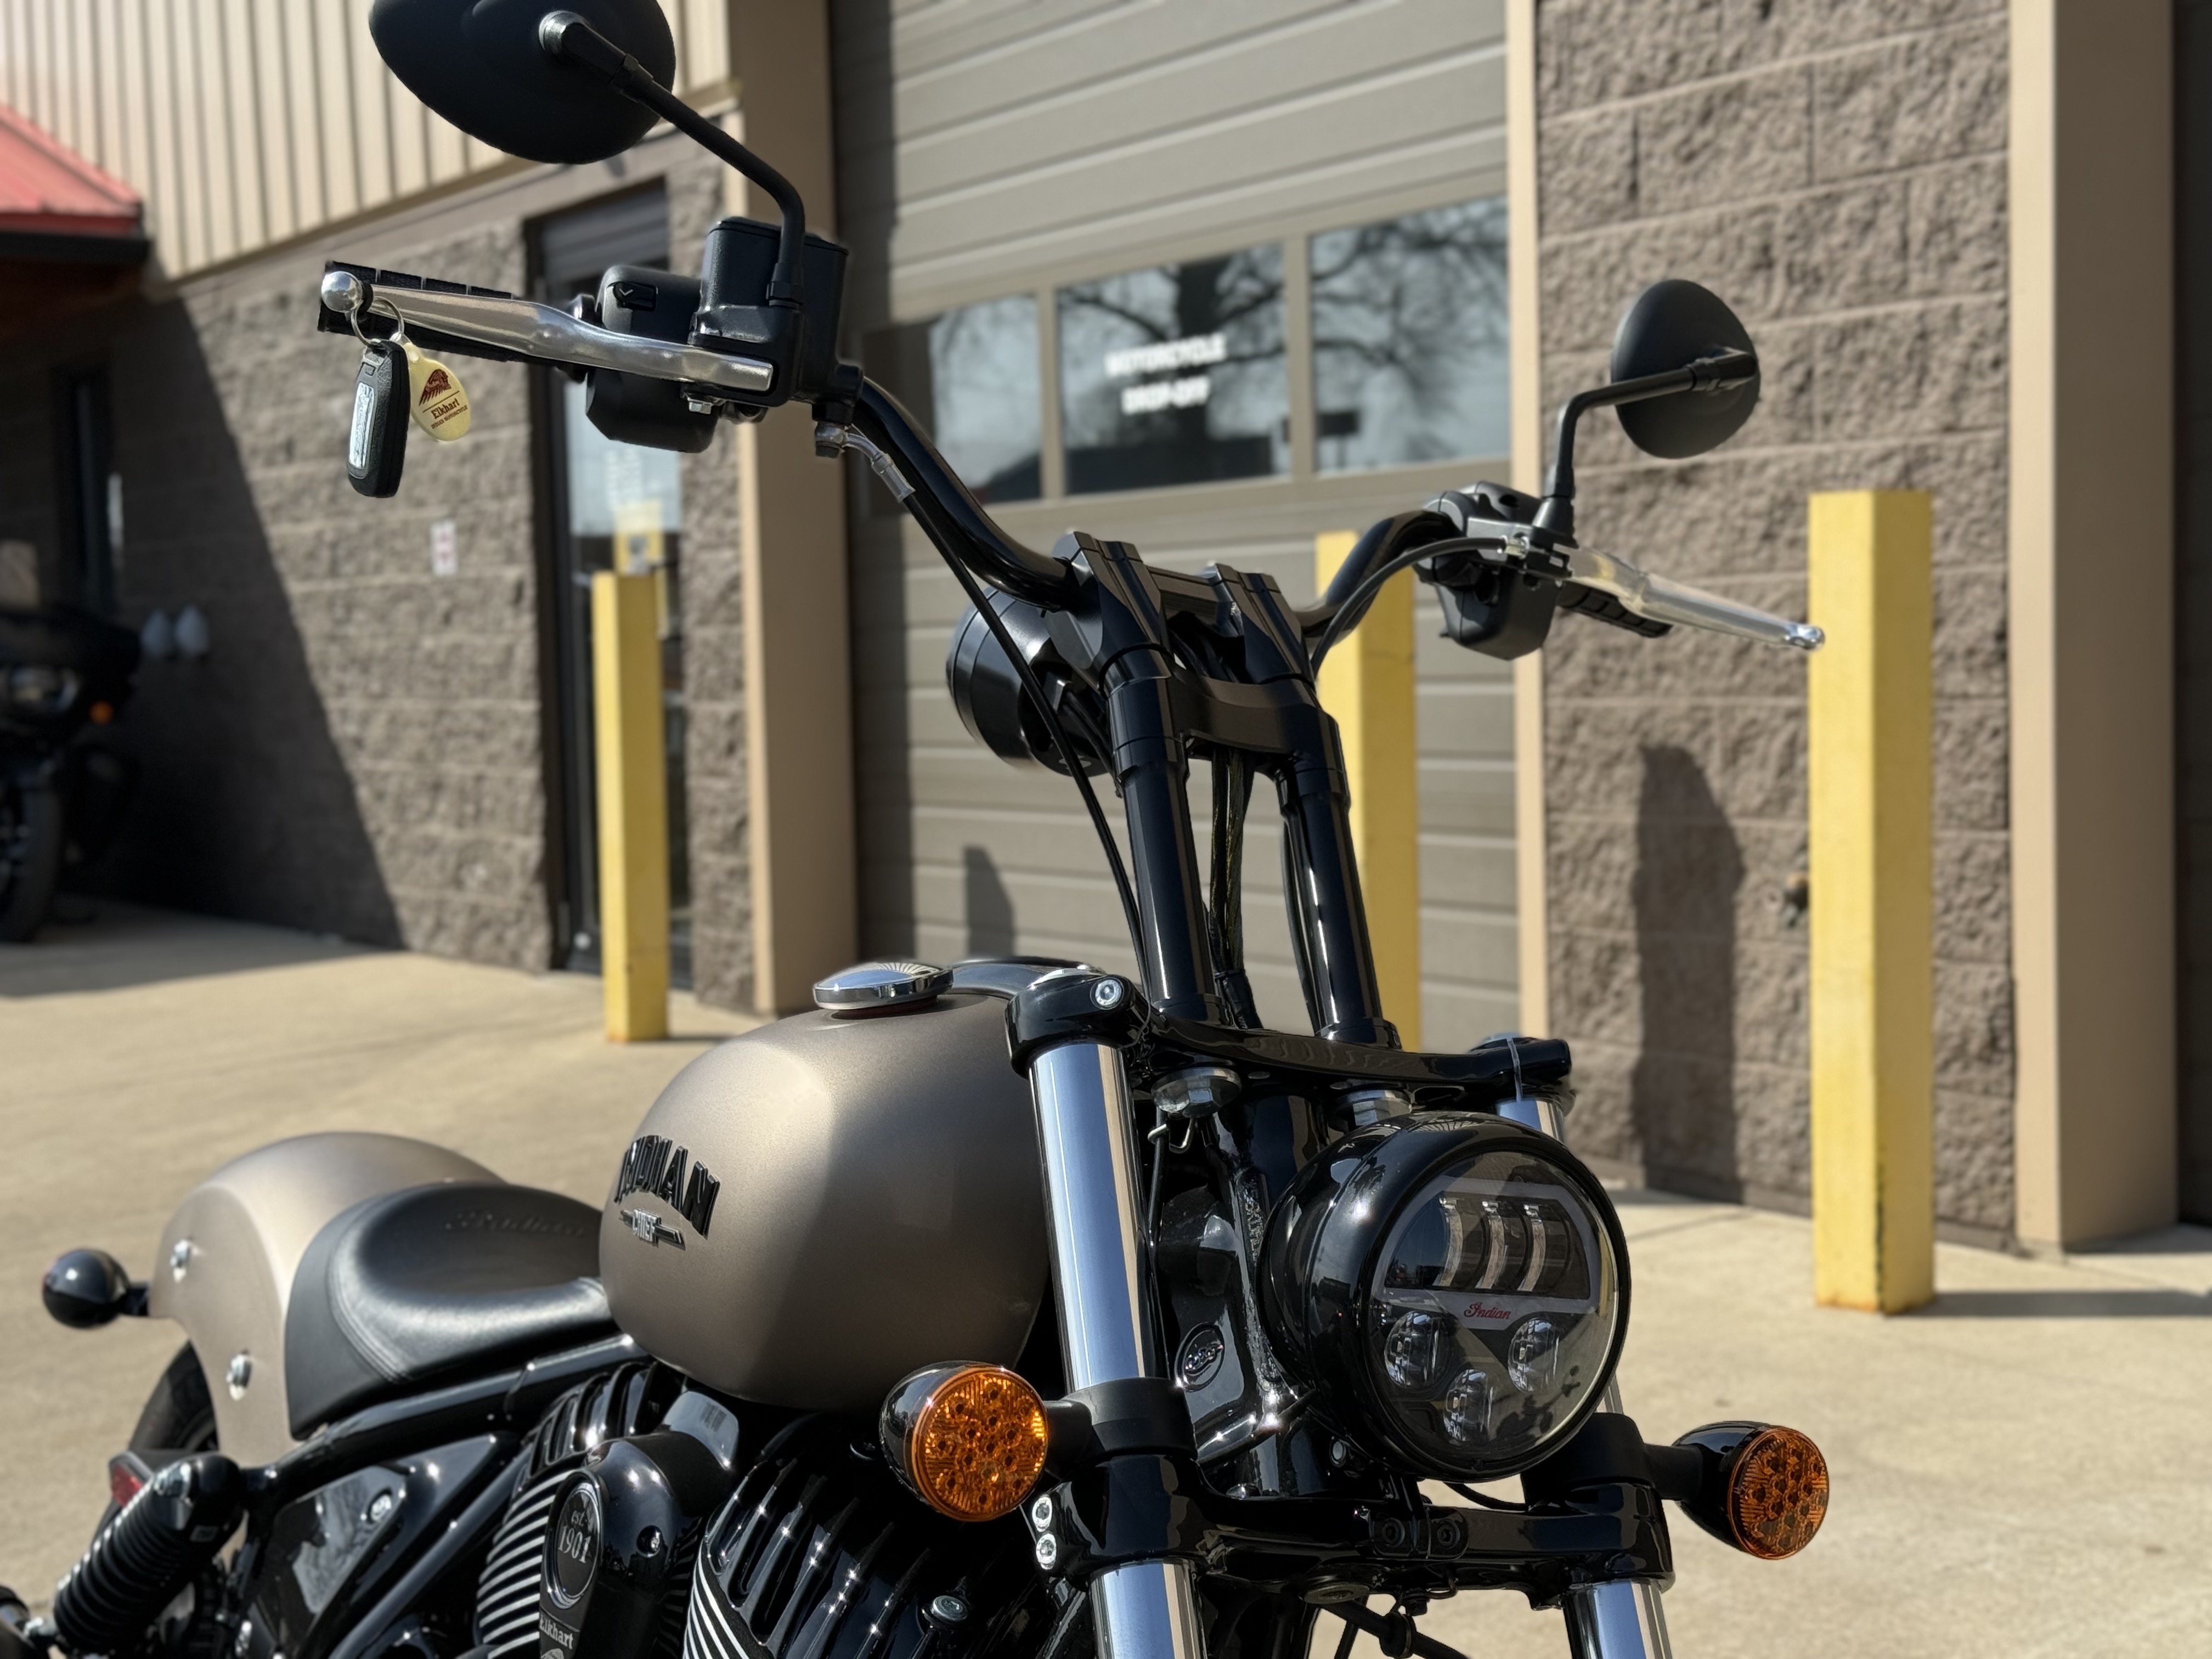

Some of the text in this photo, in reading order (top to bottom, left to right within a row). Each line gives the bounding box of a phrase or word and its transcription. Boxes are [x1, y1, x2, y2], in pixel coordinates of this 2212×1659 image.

[431, 398, 460, 419] Elkhart
[1464, 1302, 1511, 1319] Indian
[558, 1525, 591, 1563] 1901
[540, 1615, 573, 1650] Elkhart
